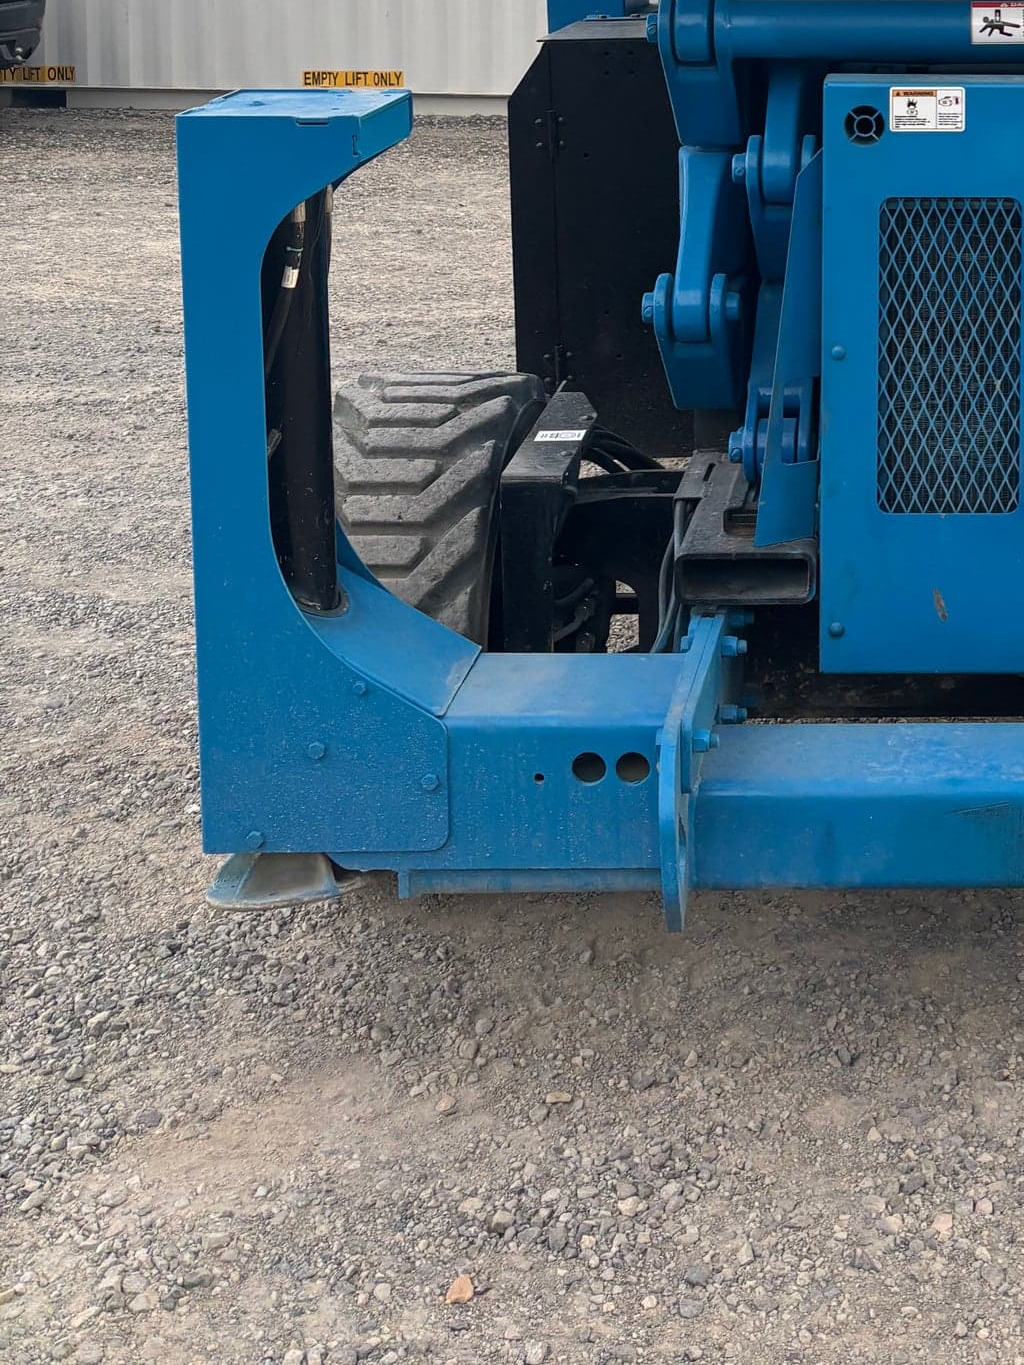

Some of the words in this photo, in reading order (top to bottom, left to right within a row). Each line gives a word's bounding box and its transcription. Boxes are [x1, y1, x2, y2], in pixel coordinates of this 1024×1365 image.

[47, 66, 75, 81] ONLY
[304, 71, 339, 86] EMPTY
[345, 71, 368, 86] LIFT
[373, 71, 402, 86] ONLY
